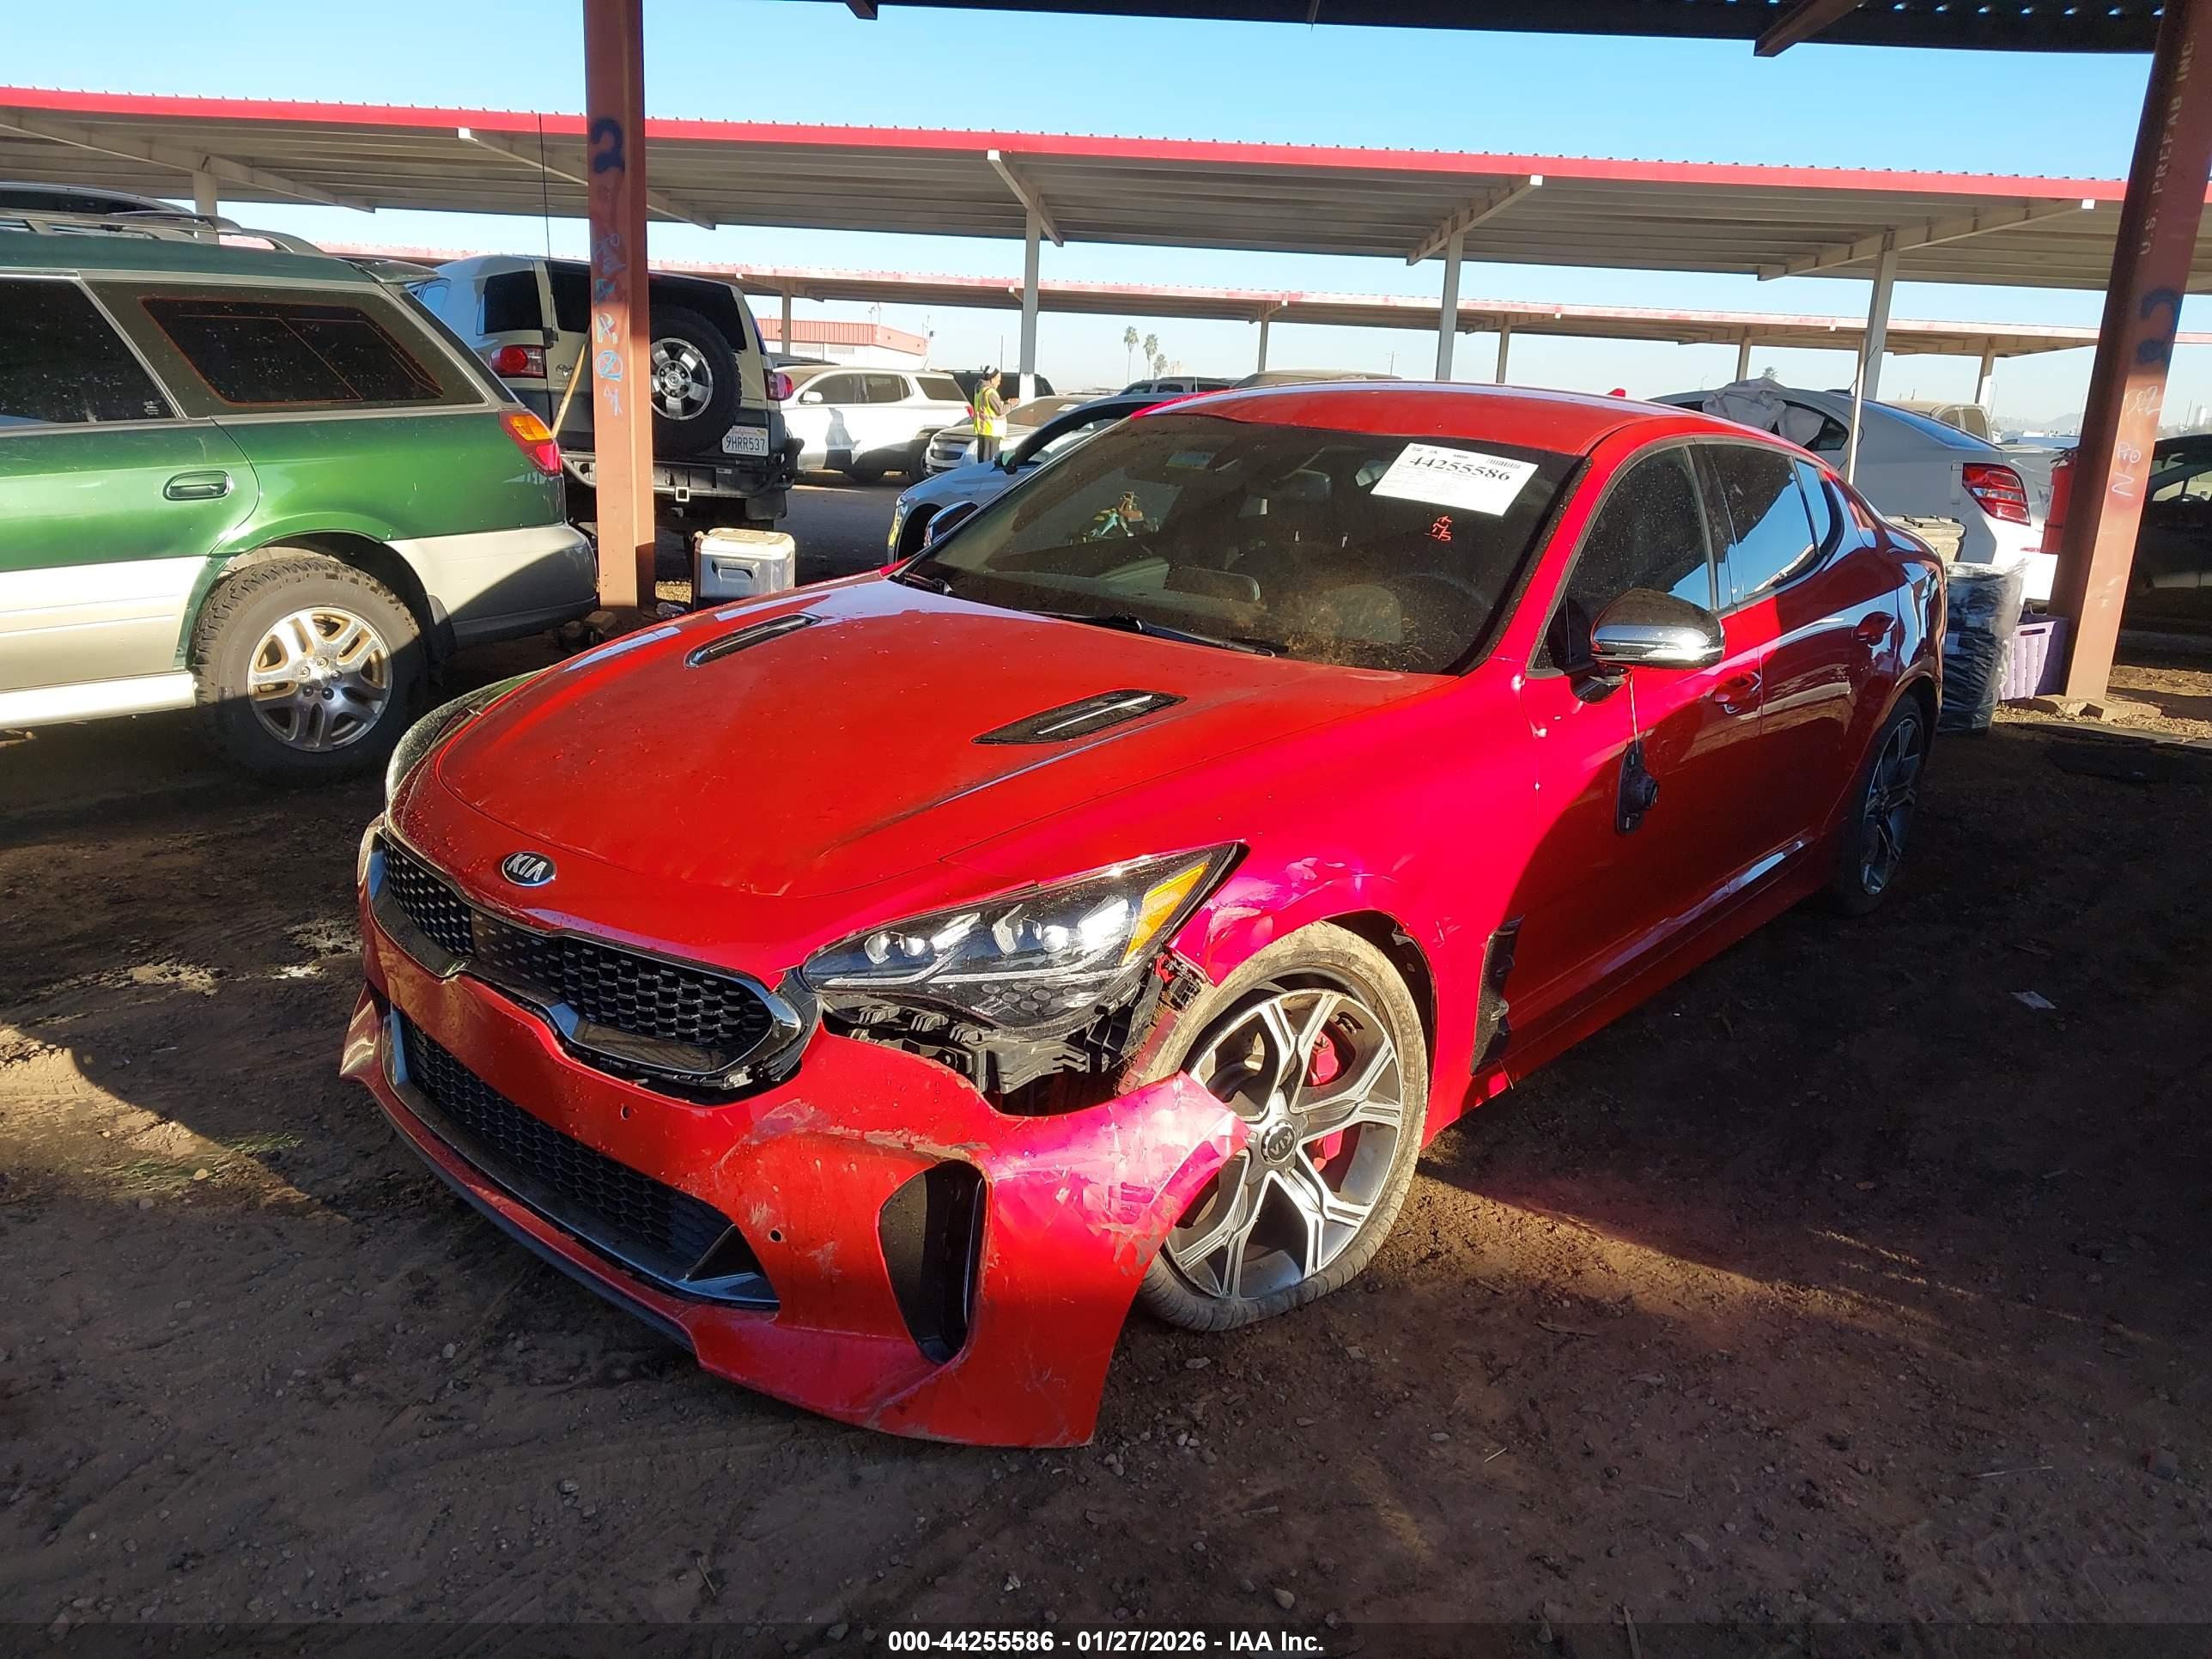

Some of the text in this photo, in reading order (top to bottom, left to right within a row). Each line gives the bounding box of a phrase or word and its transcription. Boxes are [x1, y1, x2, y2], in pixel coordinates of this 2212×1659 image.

[726, 435, 765, 452] 9HRR537
[1409, 456, 1512, 481] 44255586
[506, 854, 548, 883] KIA
[1269, 1131, 1294, 1156] KIA
